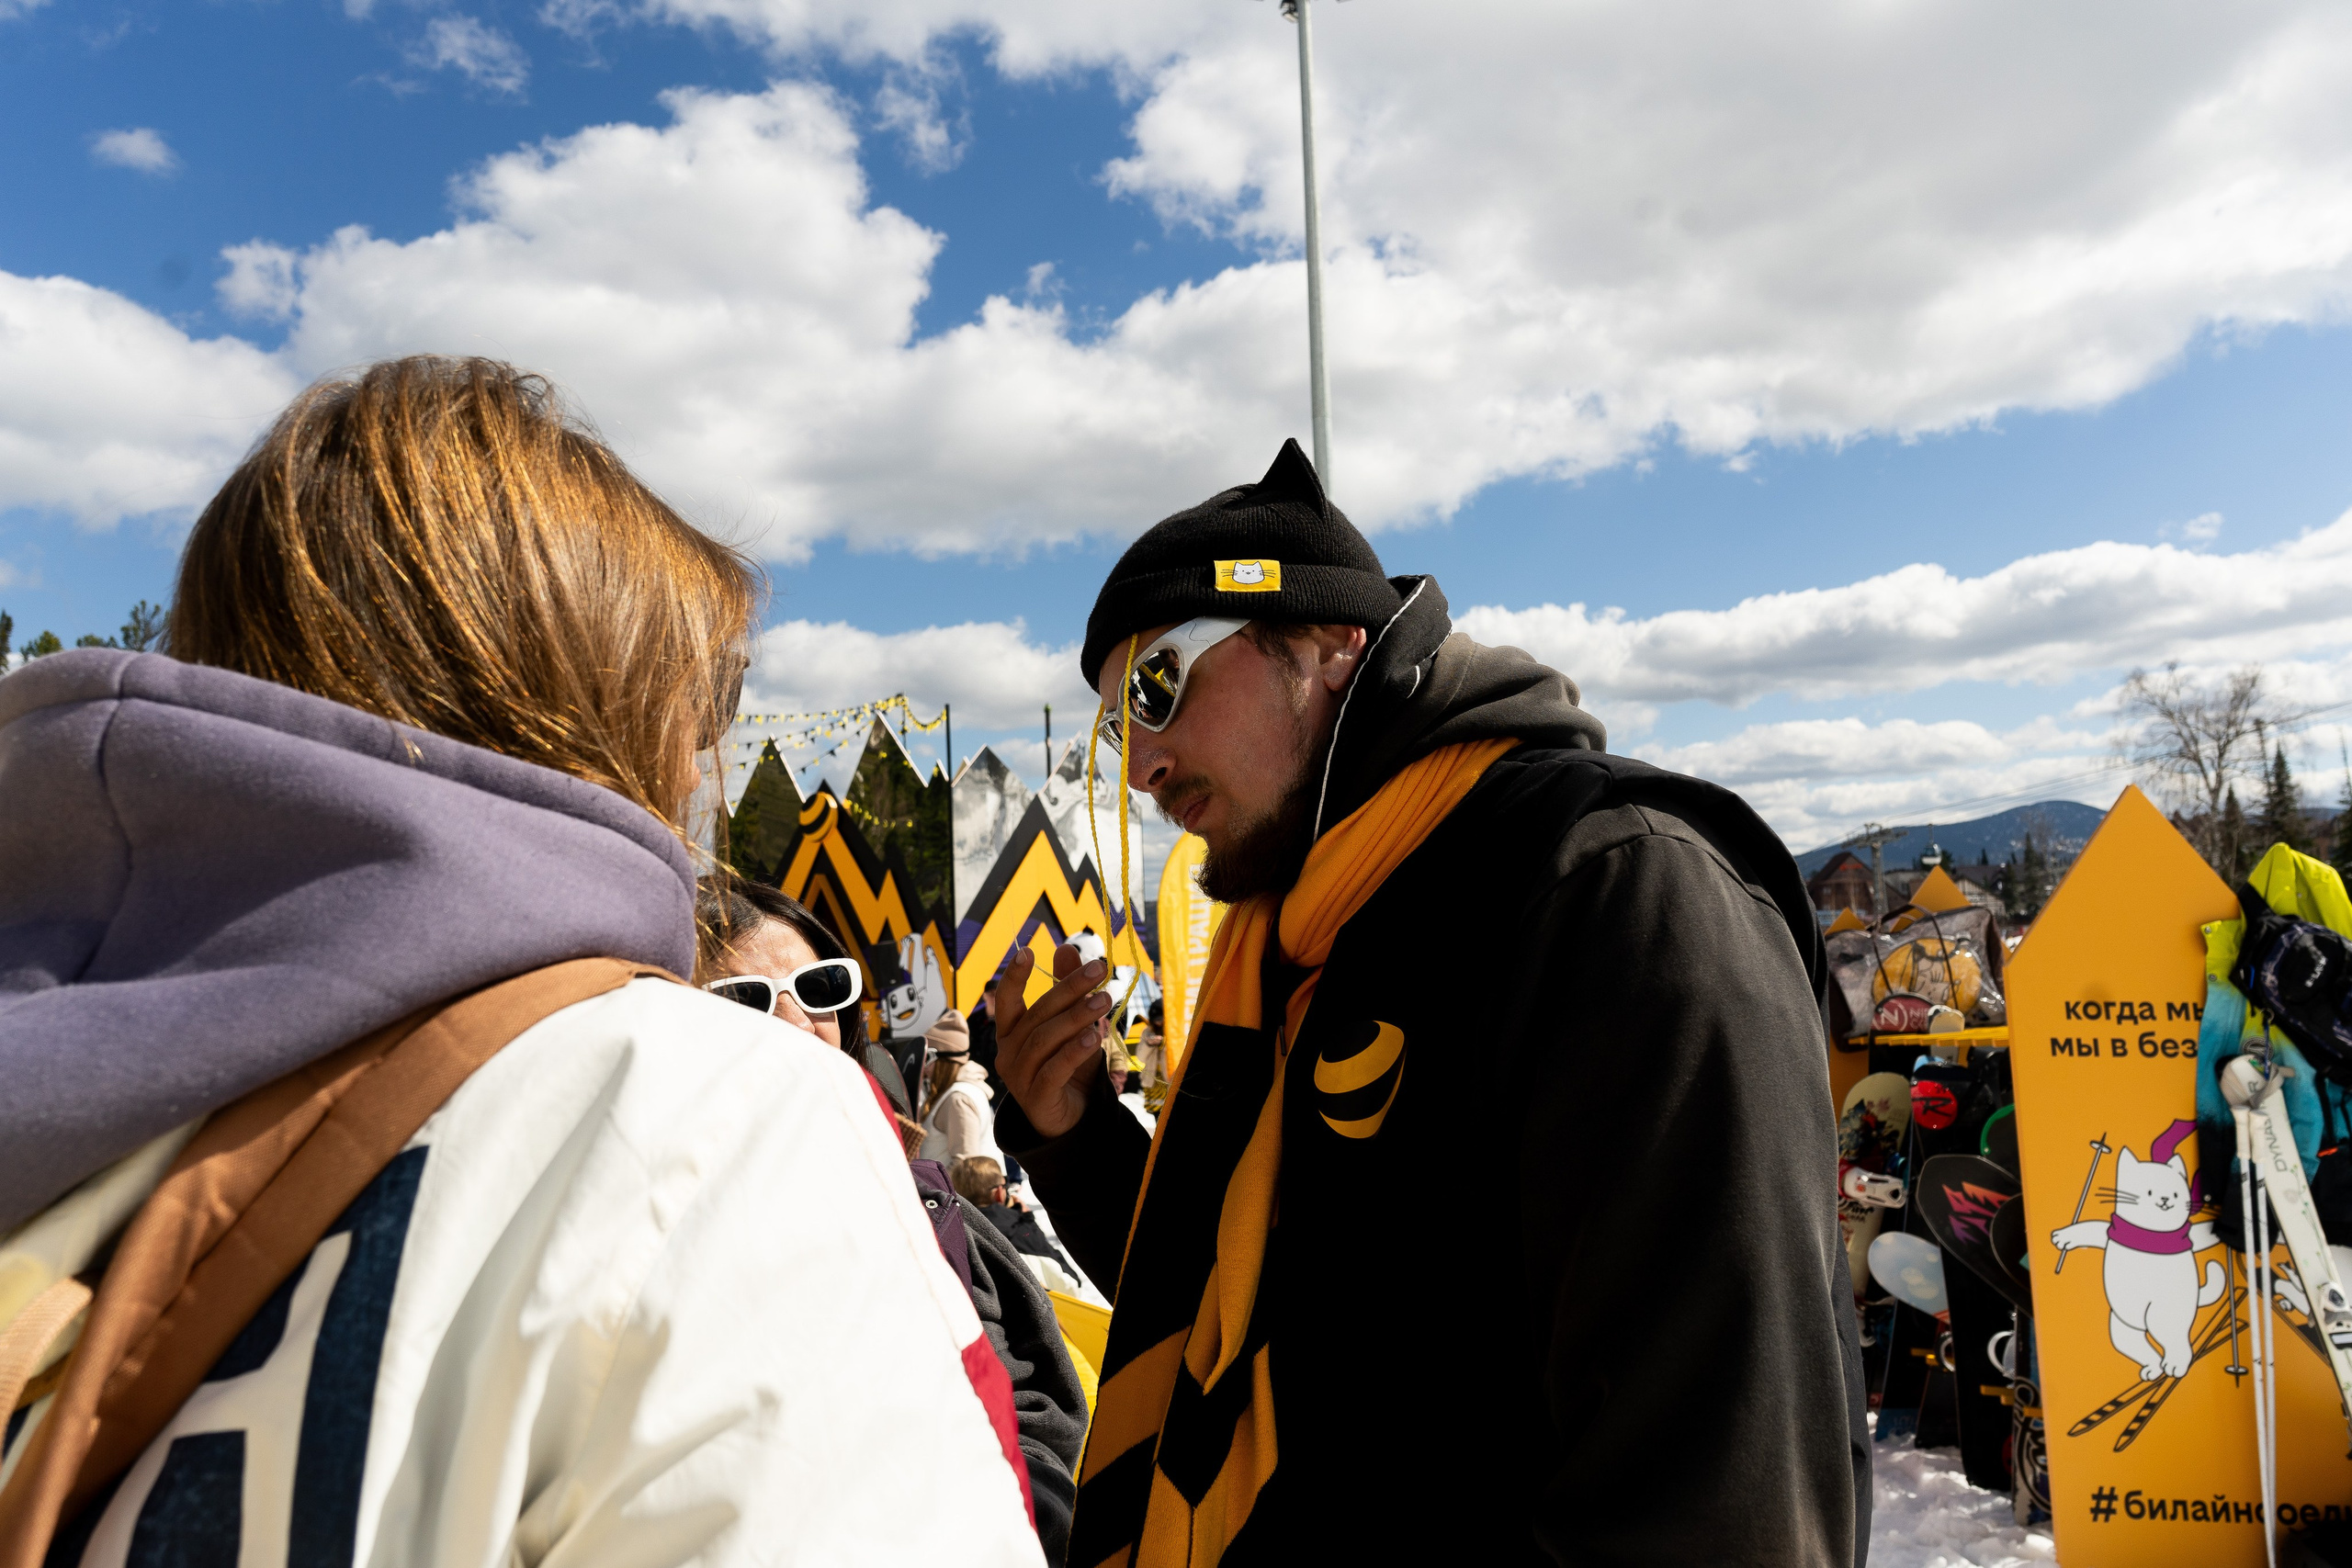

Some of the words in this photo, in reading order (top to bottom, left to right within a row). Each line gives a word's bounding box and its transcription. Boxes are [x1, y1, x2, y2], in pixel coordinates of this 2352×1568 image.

[2064, 1000, 2157, 1025] когда
[2051, 1037, 2099, 1057] мы
[2110, 1037, 2128, 1057] в
